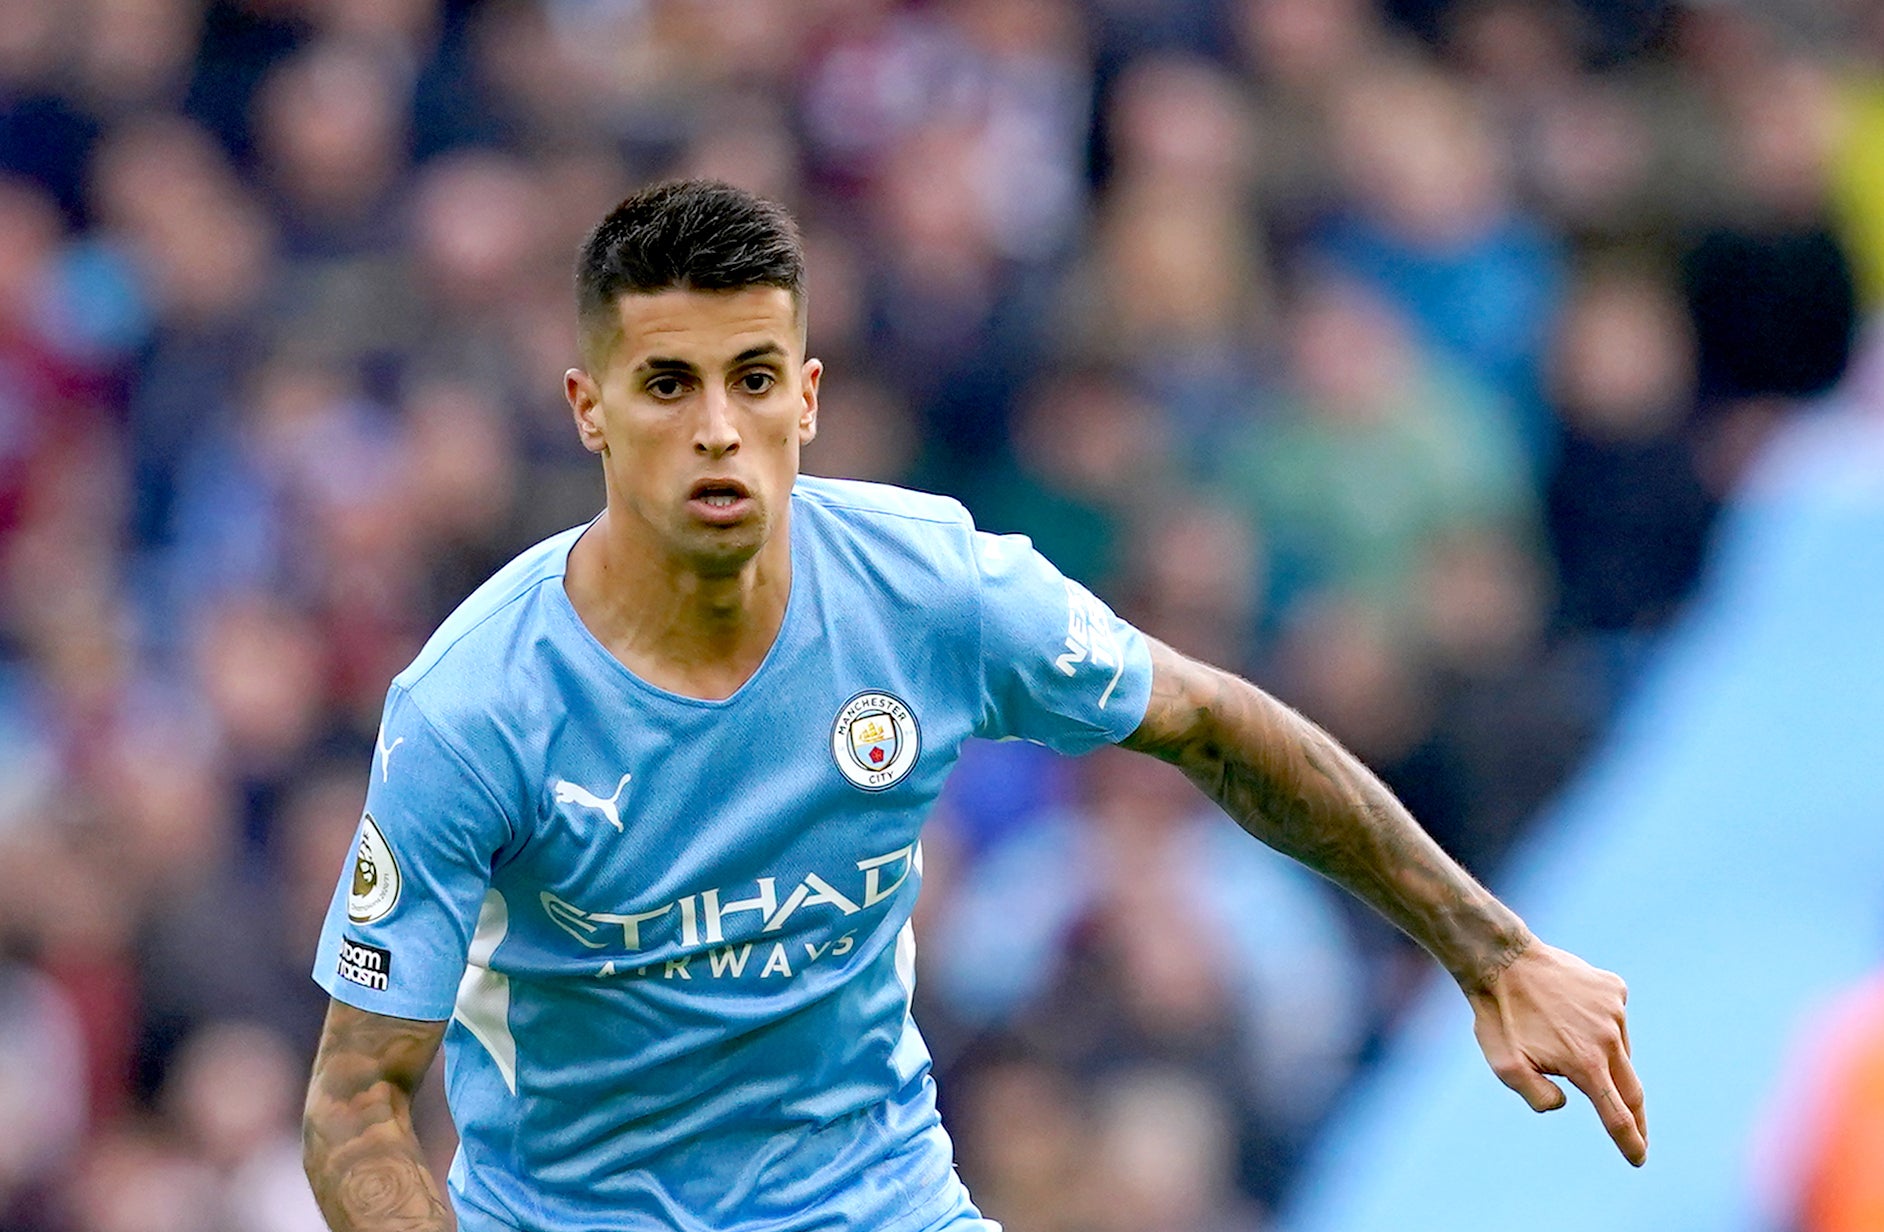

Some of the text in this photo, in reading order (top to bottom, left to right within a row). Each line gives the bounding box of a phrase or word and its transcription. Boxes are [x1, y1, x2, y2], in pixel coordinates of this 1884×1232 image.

[838, 697, 907, 735] MANCHESTER
[868, 770, 895, 785] CITY
[540, 845, 912, 951] ETIHAD
